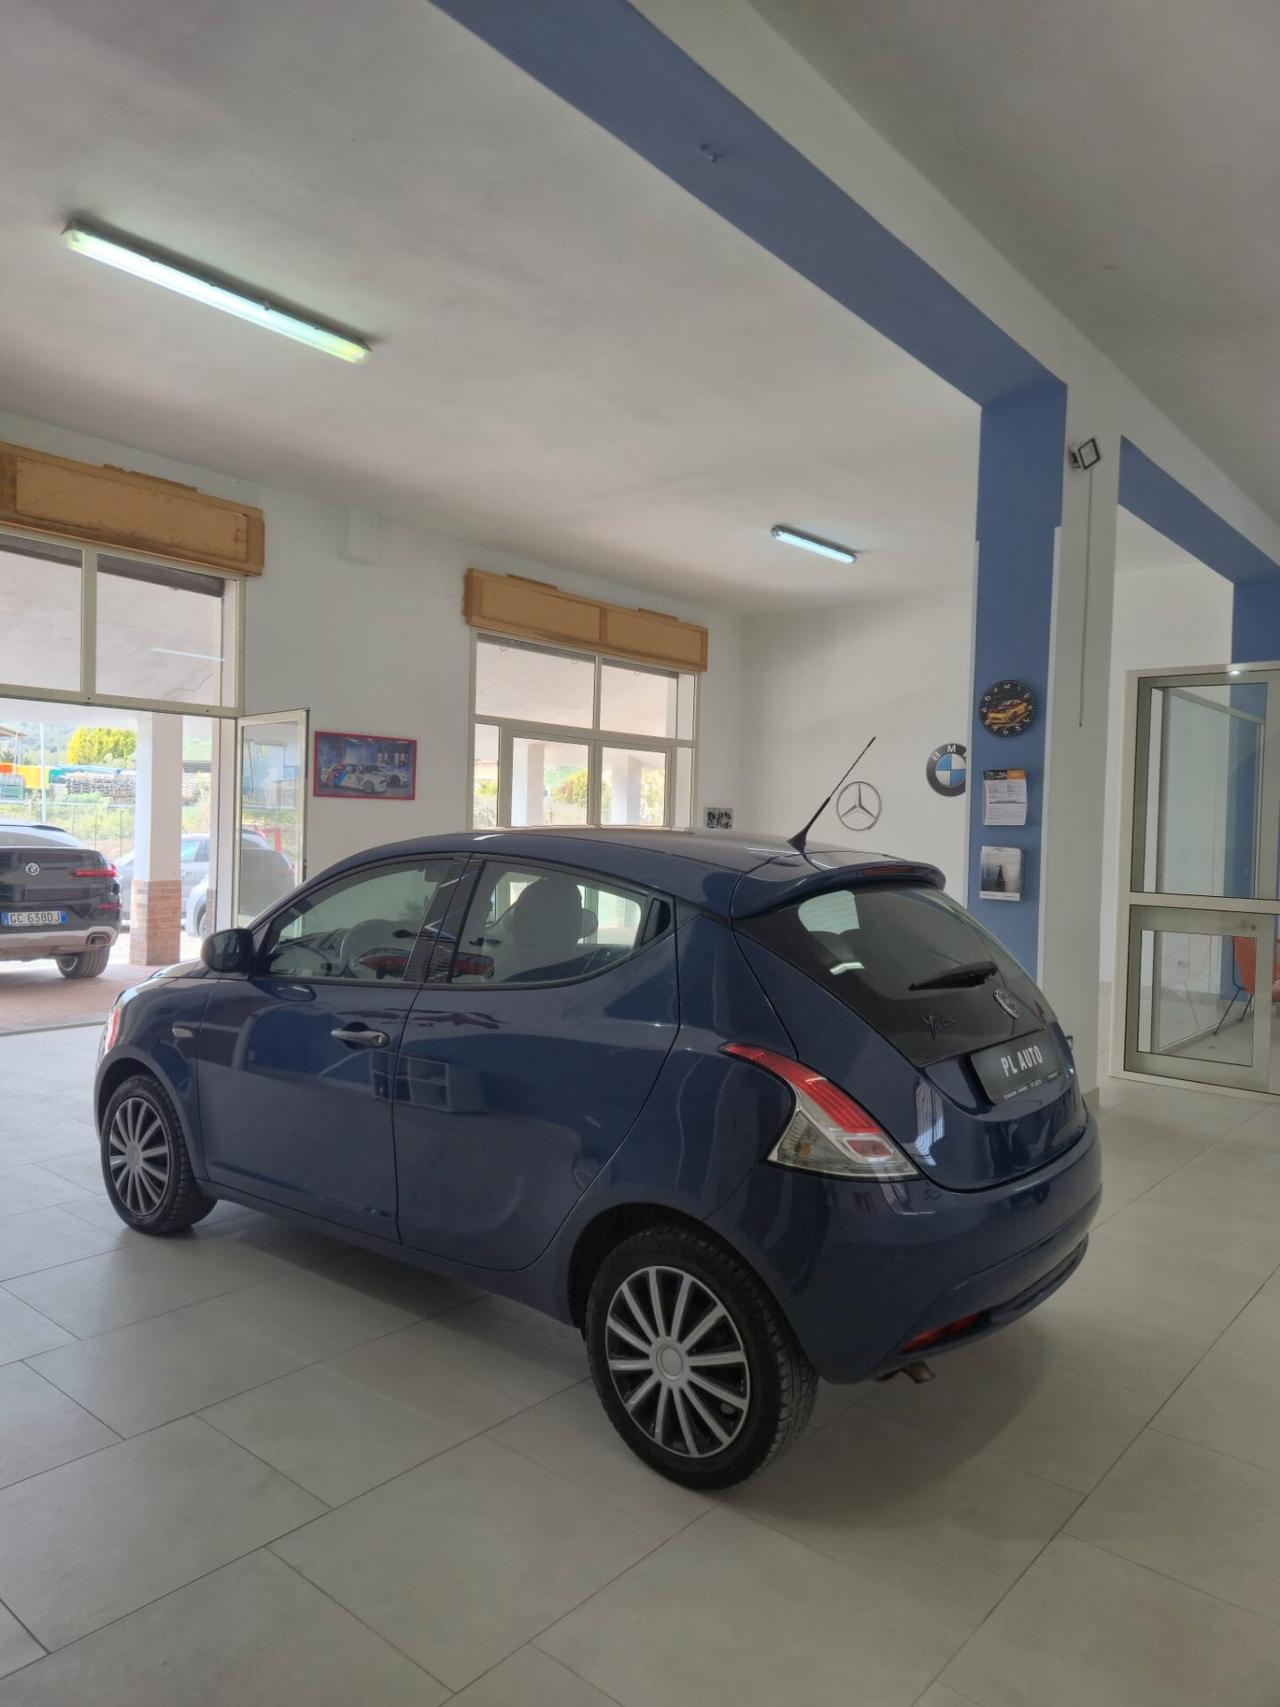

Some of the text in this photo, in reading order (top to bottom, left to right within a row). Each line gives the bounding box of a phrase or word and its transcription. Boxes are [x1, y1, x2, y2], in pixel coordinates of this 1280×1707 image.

[931, 744, 967, 761] BM
[1000, 1044, 1043, 1078] PL AUTO
